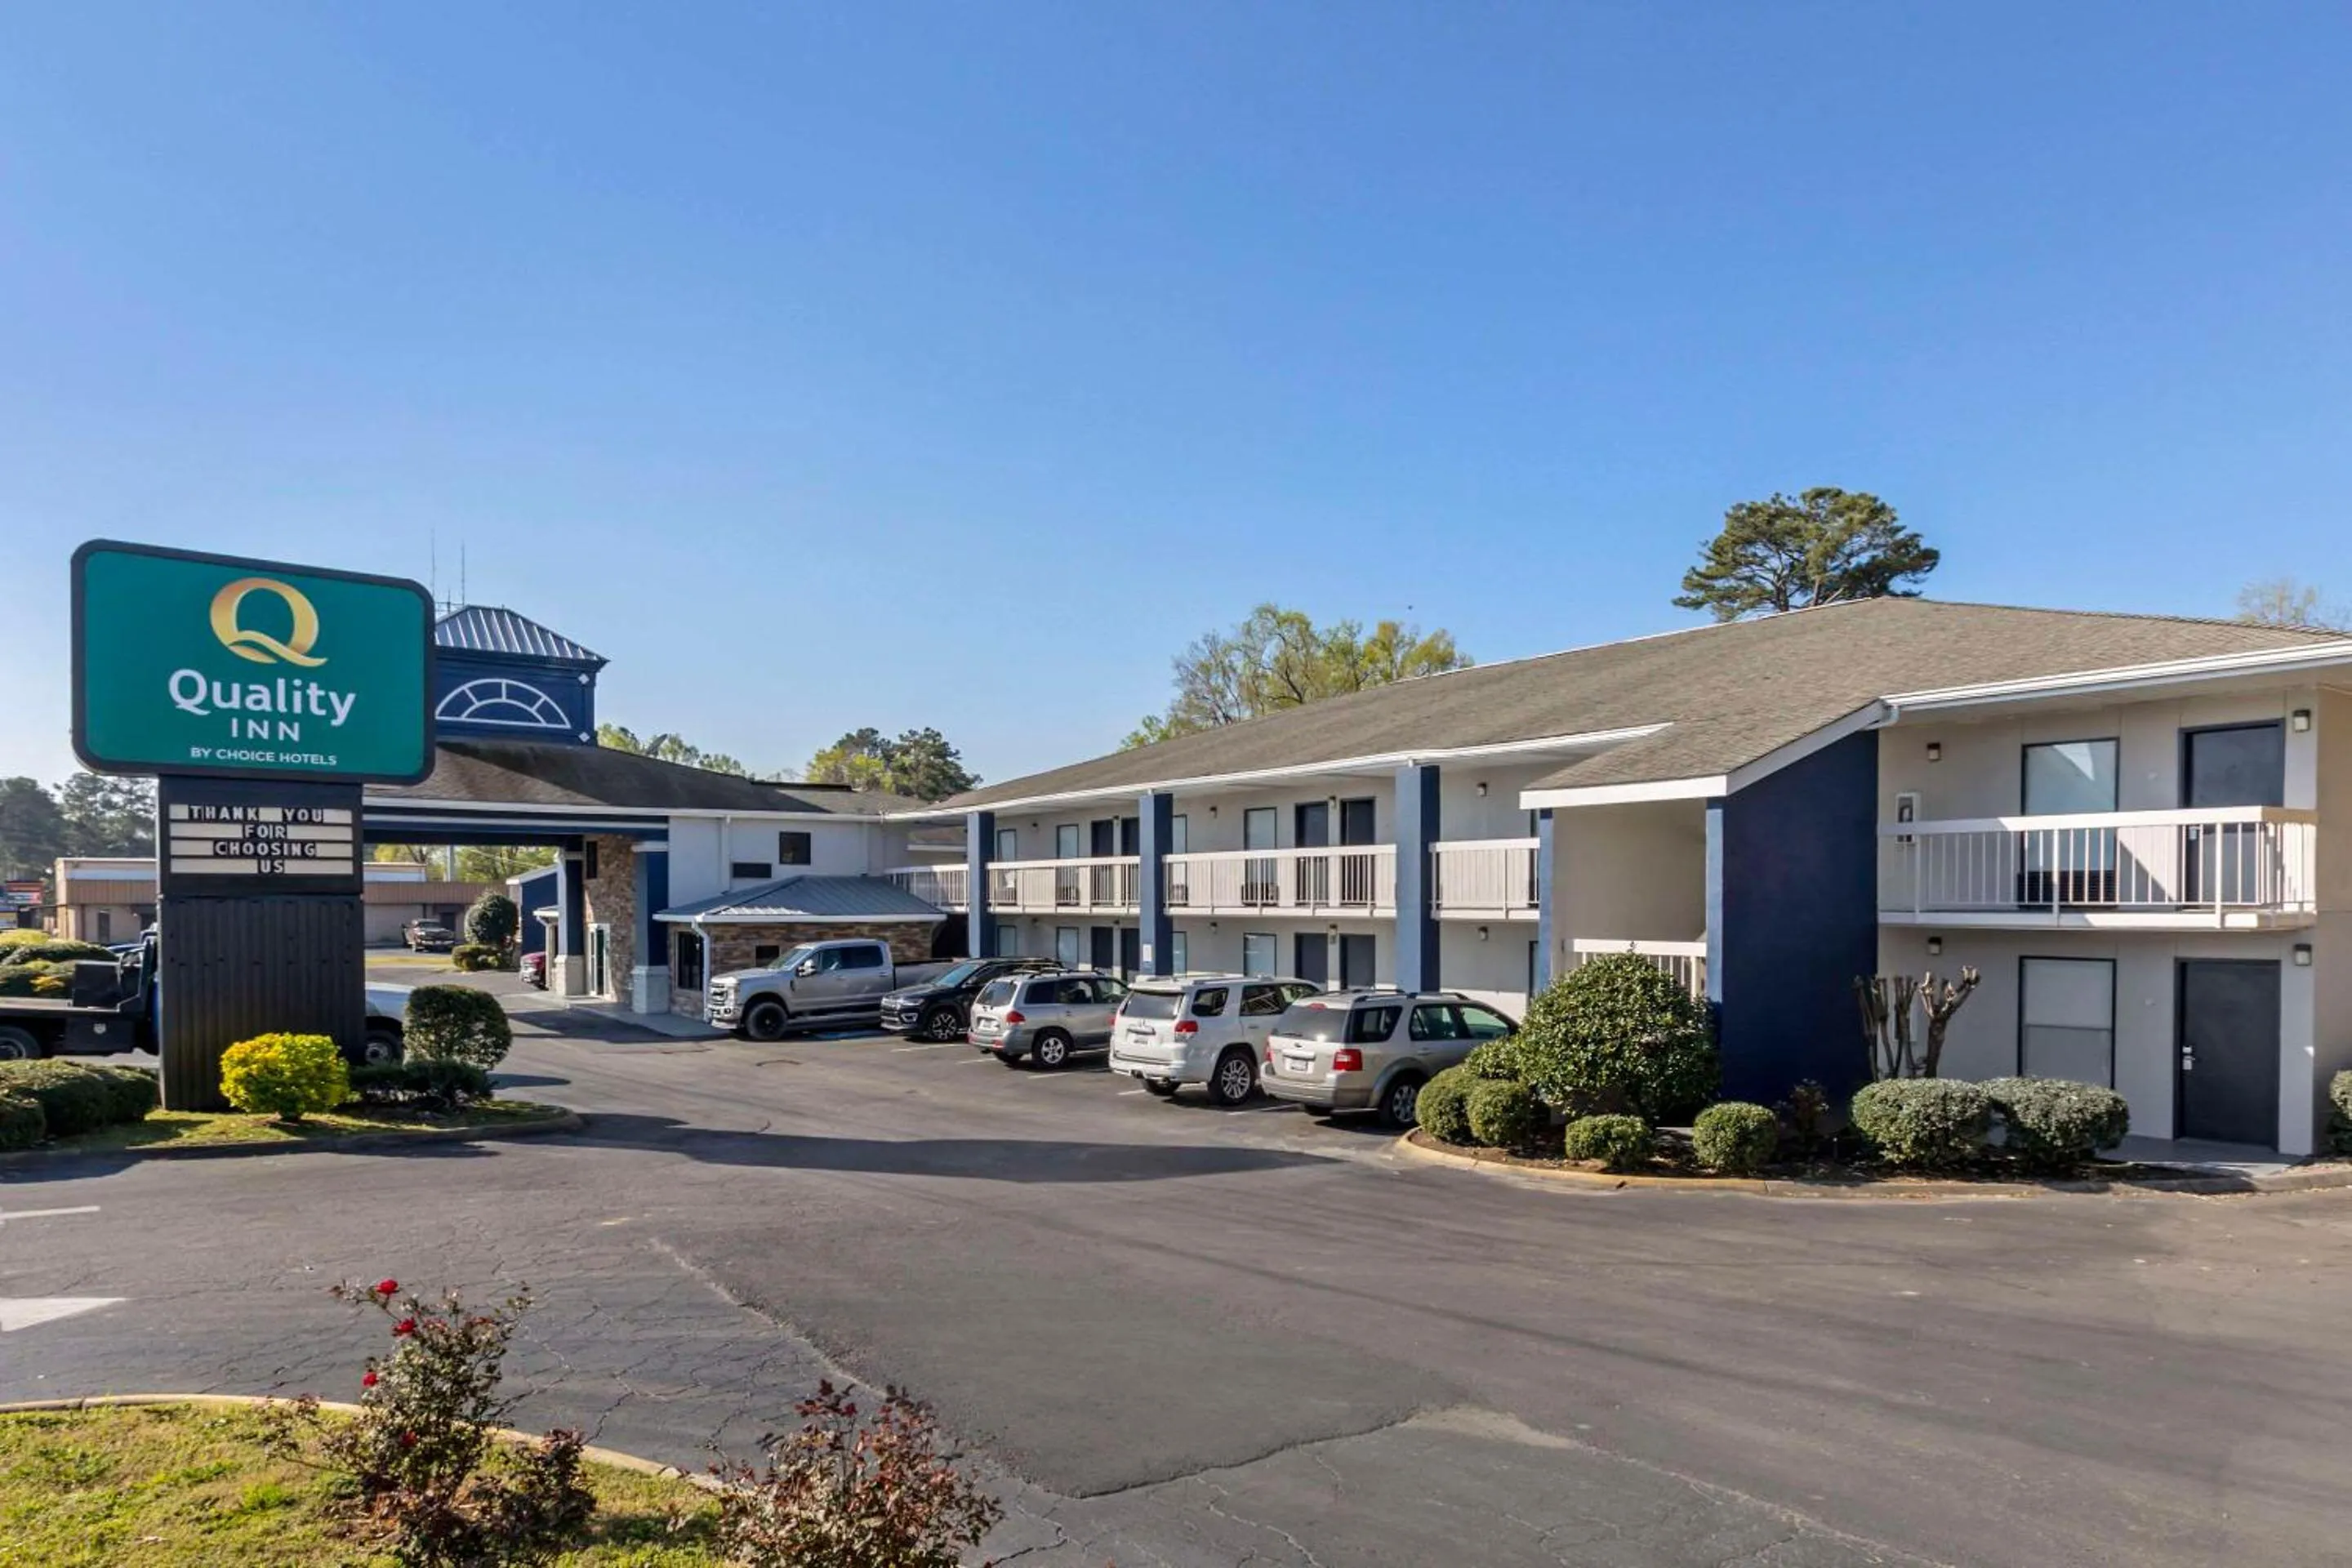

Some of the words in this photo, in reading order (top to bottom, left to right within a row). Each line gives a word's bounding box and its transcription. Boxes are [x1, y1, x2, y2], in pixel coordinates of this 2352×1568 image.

[210, 577, 328, 668] Q
[168, 668, 357, 727] Quality
[231, 717, 301, 742] INN
[190, 746, 212, 759] BY
[216, 748, 275, 763] CHOICE
[279, 753, 338, 766] HOTELS
[189, 805, 259, 821] THANK
[284, 808, 323, 822] YOU
[244, 824, 286, 839] FOR
[215, 842, 316, 856] CHOOSING
[260, 860, 284, 874] US
